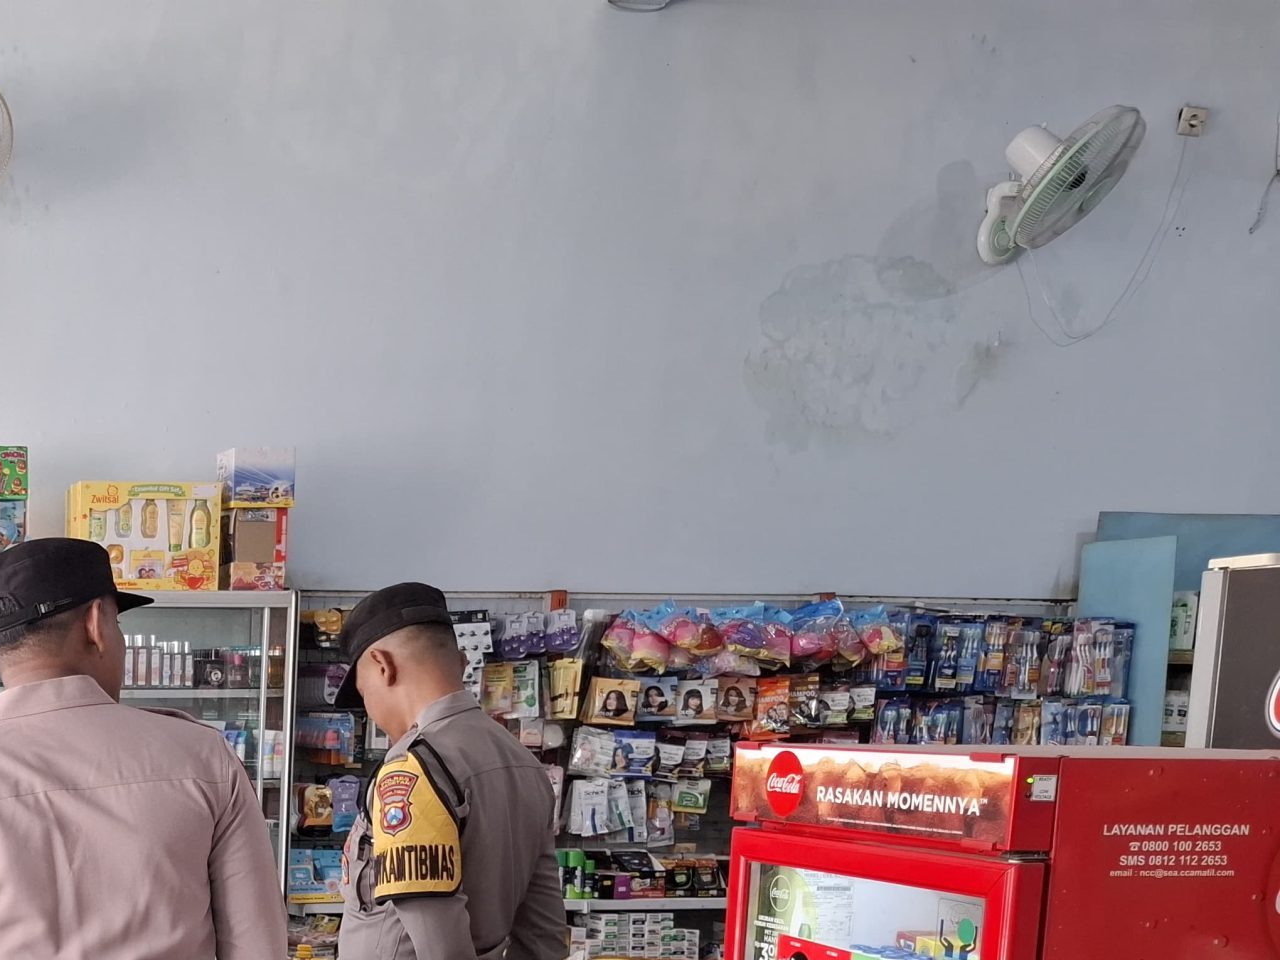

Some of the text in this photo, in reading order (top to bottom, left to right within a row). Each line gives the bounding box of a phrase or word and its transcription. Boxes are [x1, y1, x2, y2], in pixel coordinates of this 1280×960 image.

[91, 494, 119, 504] Zwitsal
[767, 772, 801, 795] Coca-Cola
[816, 785, 883, 807] RASAKAN
[1103, 823, 1250, 837] LAYANAN PELANGGAN
[1142, 841, 1222, 852] 0800 100 2653
[1119, 855, 1228, 866] SMS 0812 112 2653
[1109, 869, 1133, 878] email
[1139, 869, 1235, 879] ncc@sea.ccamatil.com
